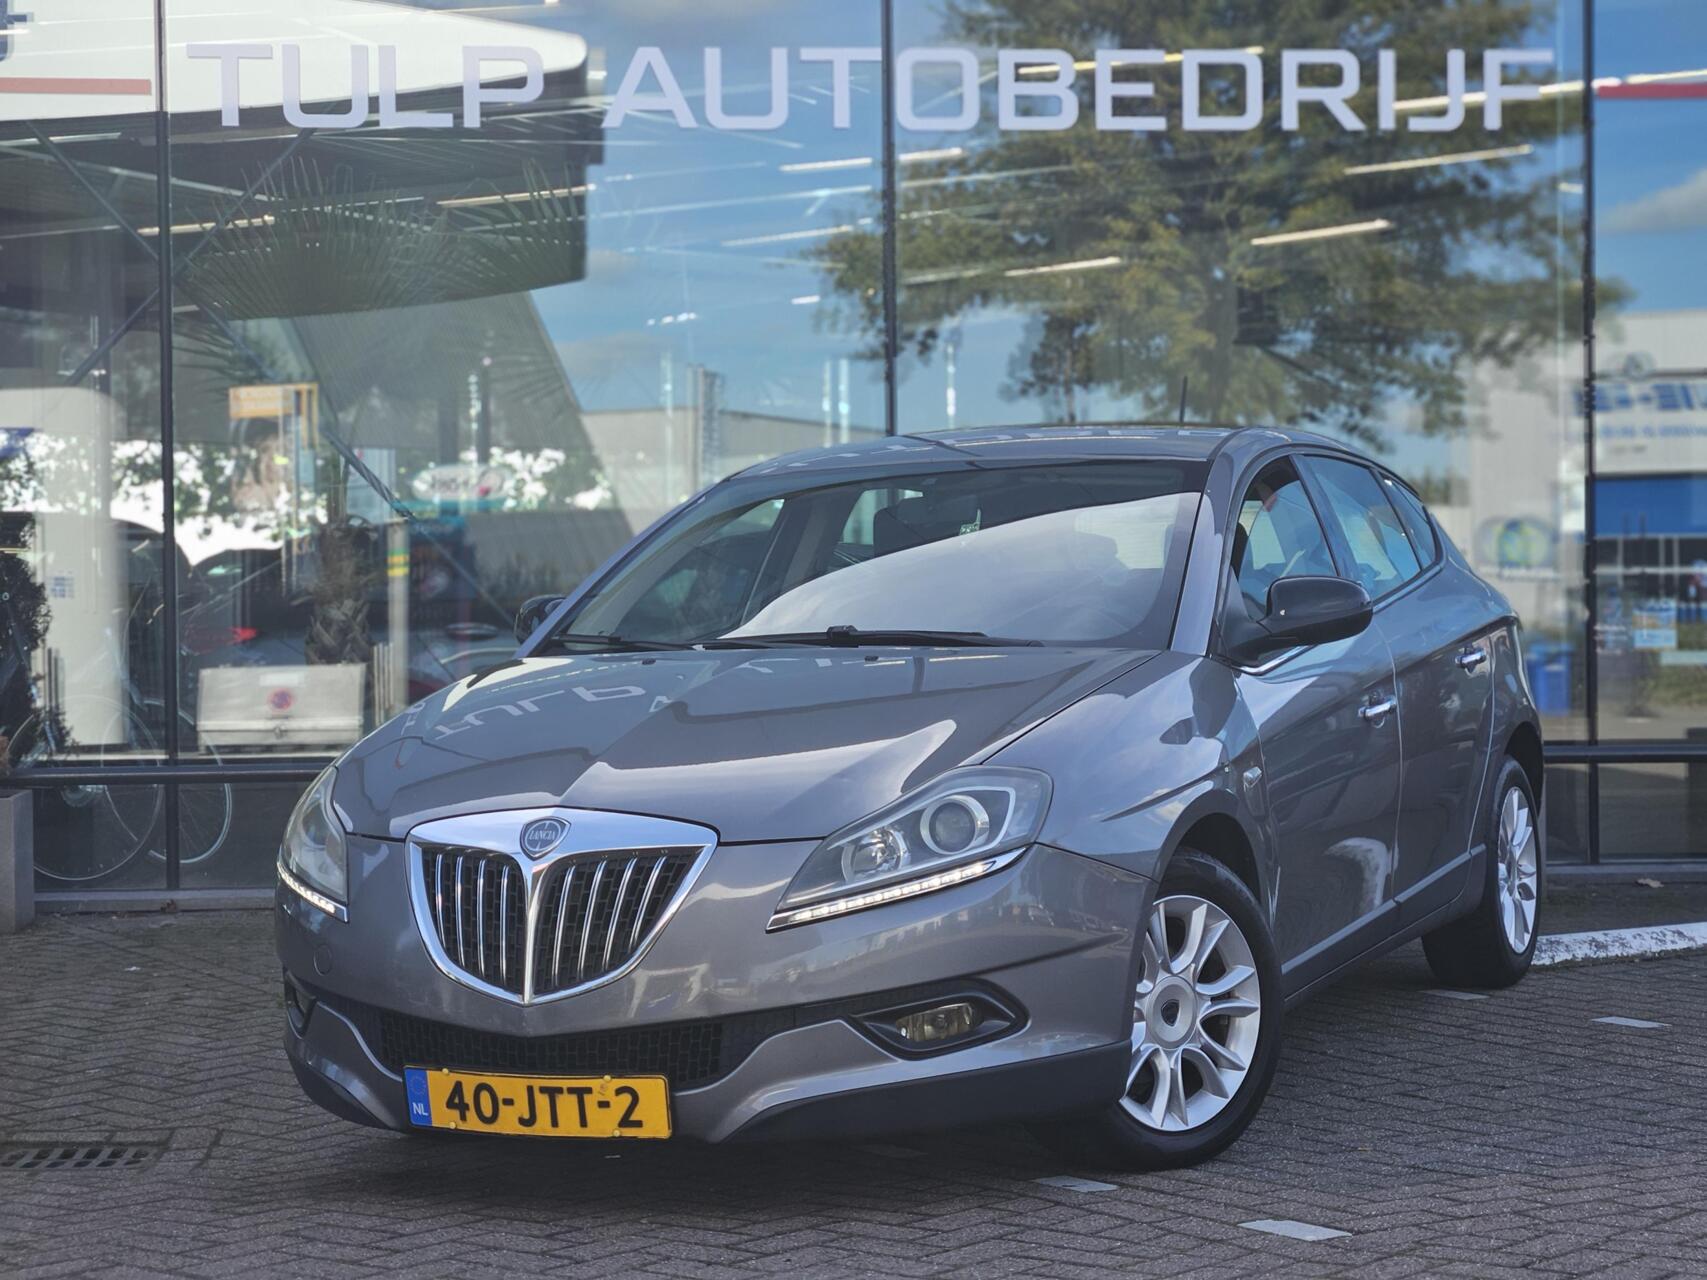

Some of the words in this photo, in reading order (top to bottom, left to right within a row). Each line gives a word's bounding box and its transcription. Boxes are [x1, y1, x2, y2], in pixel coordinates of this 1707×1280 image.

[186, 44, 544, 128] TULP
[600, 46, 1554, 132] AUTOBEDRIJF
[527, 829, 556, 841] LANCIA
[412, 1102, 429, 1116] NL
[445, 1080, 643, 1128] 40-JTT-2
